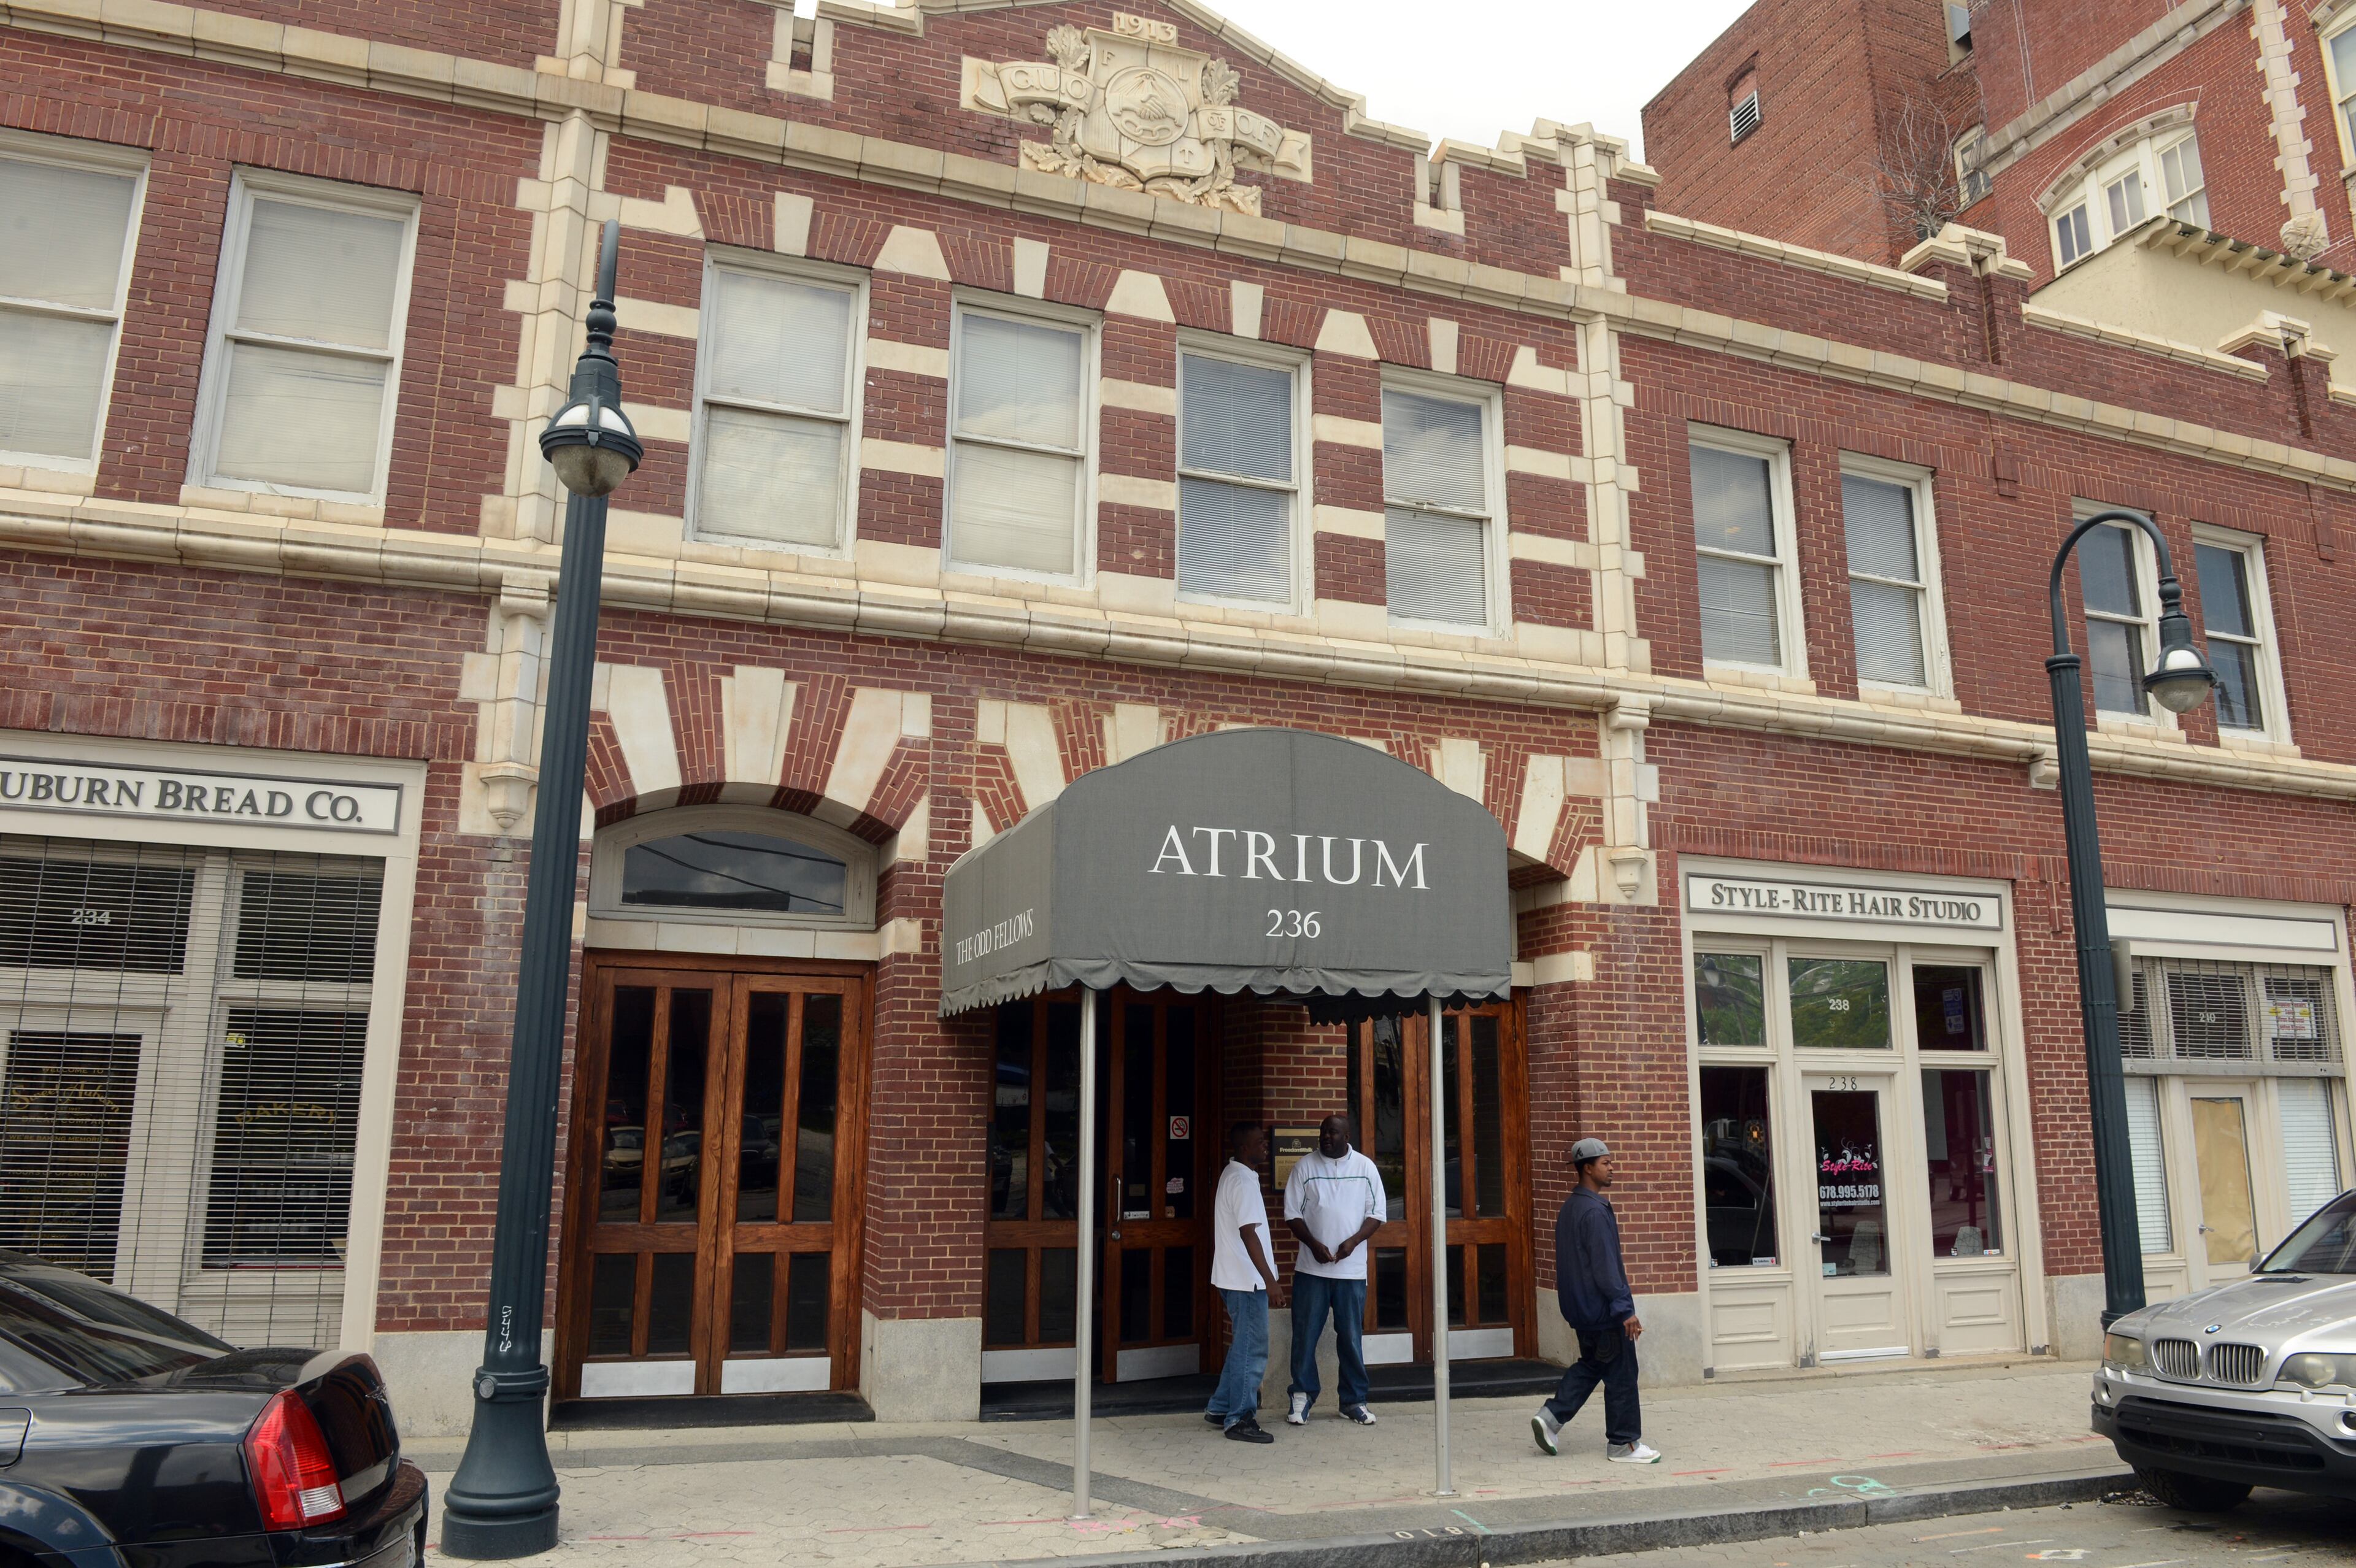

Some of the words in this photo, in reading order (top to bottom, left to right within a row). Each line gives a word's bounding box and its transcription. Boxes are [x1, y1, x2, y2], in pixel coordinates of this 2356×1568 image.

[1116, 12, 1176, 42] 1913
[1179, 148, 1194, 164] T
[154, 779, 293, 817] BREAD
[306, 790, 363, 823] CO.
[1147, 824, 1431, 890] ATRIUM
[71, 909, 111, 925] 234
[1848, 893, 1904, 917] HAIR
[1909, 896, 1981, 921] STUDIO
[956, 937, 972, 966] THE
[974, 928, 992, 958] ODD
[994, 908, 1033, 951] FELLOWS
[1266, 909, 1322, 939] 236
[1829, 998, 1850, 1011] 238
[1829, 1077, 1857, 1091] 238
[1819, 1185, 1879, 1199] 678.995.5178
